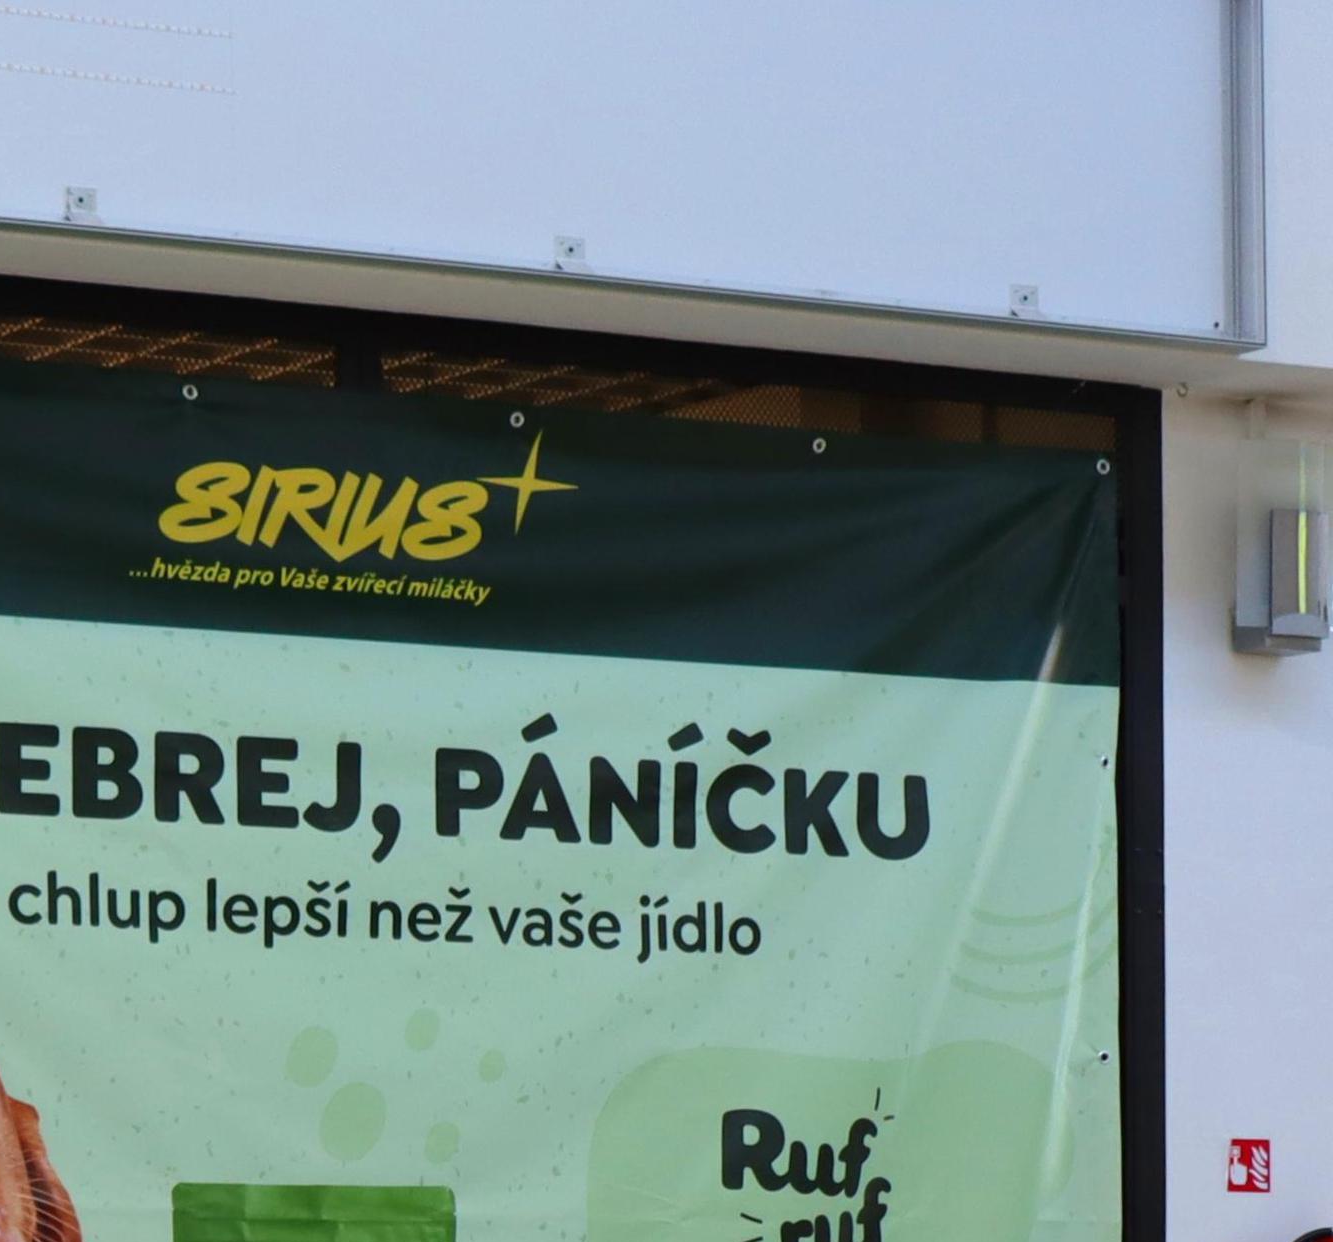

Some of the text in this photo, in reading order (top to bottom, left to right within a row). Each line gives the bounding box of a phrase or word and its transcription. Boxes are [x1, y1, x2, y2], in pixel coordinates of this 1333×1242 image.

[158, 461, 489, 563] SIRIUS
[234, 567, 274, 589] pro
[280, 566, 329, 592] Vaše
[332, 570, 406, 597] zvířecí
[407, 577, 491, 607] miláčky
[435, 712, 931, 862] PÁNÍČKU
[7, 869, 186, 945] chlup
[206, 877, 351, 949] lepší
[368, 886, 473, 943] než
[488, 891, 621, 951] vaše
[636, 894, 762, 964] jídlo
[721, 1108, 879, 1198] Ruf
